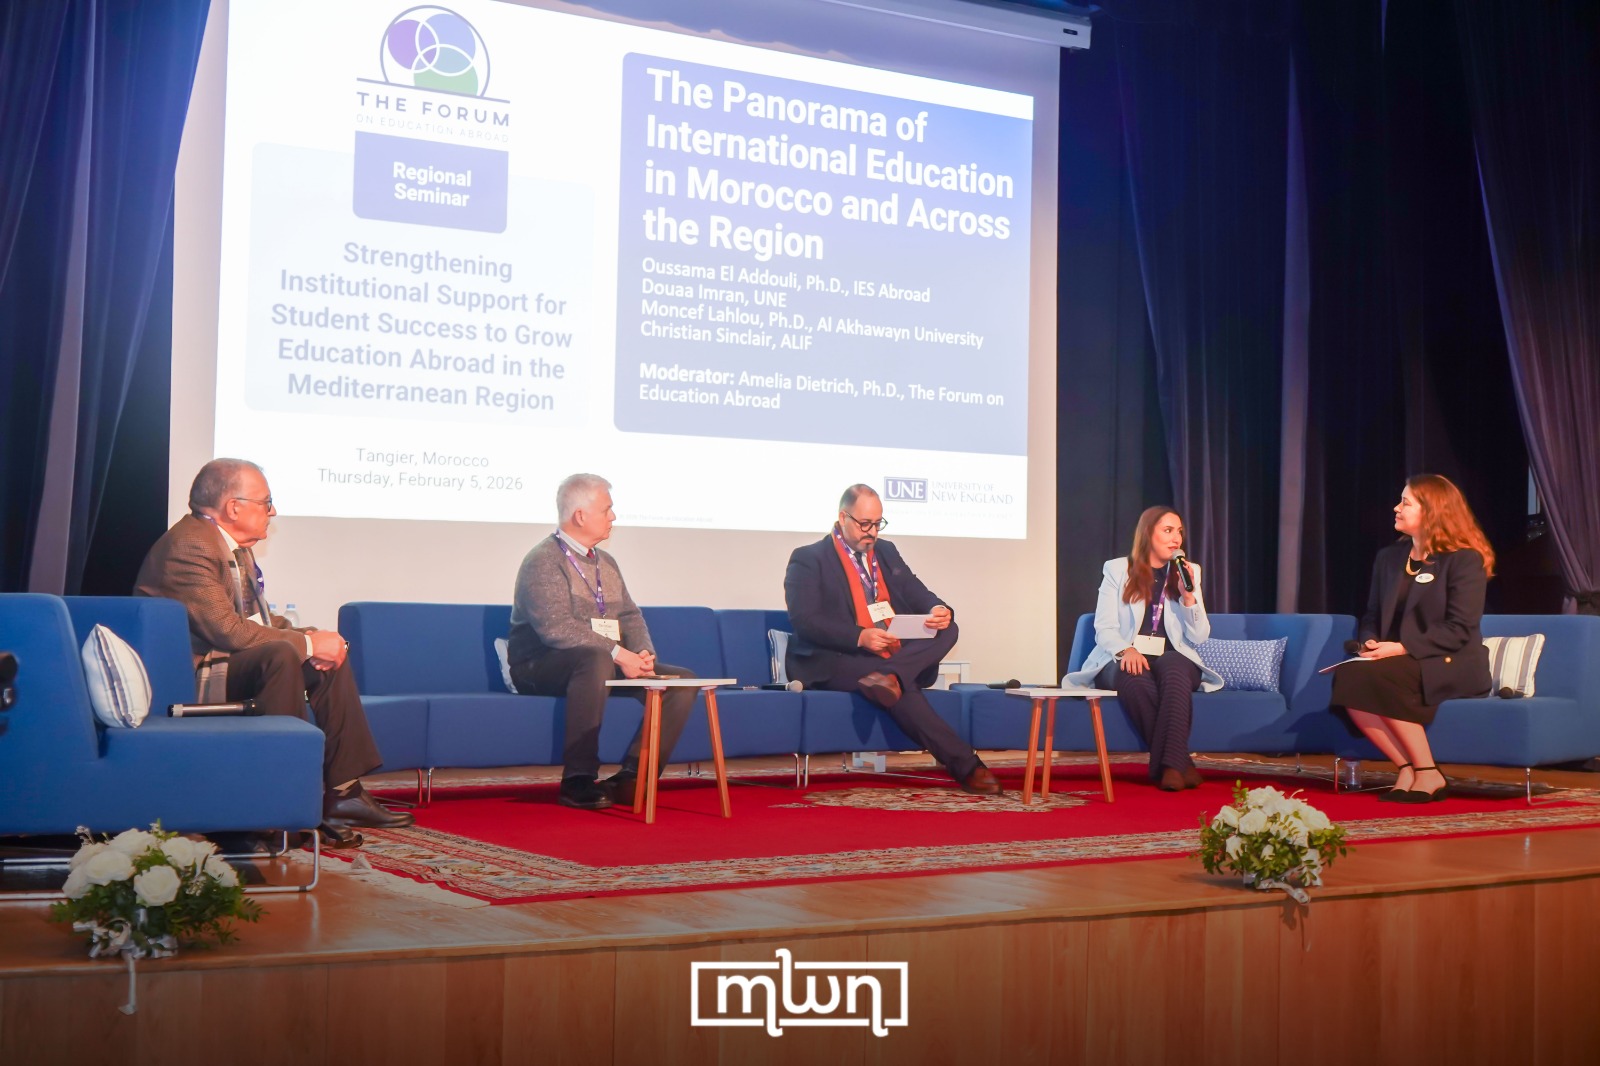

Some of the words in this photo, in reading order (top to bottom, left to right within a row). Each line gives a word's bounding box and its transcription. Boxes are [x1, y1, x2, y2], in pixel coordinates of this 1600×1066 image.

[356, 92, 407, 112] THE
[422, 102, 509, 127] FORUM
[647, 68, 712, 109] The
[724, 81, 887, 138] Panorama
[896, 112, 928, 142] of
[356, 114, 373, 124] ON
[381, 117, 454, 135] EDUCATION
[460, 128, 509, 142] ABROAD
[393, 162, 471, 187] Regional
[647, 114, 856, 176] International
[867, 149, 1013, 198] Education
[394, 183, 469, 207] Seminar
[645, 160, 676, 196] in
[688, 166, 833, 216] Morocco
[842, 194, 898, 225] and
[907, 198, 1010, 239] Across
[643, 207, 699, 245] the
[710, 215, 824, 261] Region
[343, 242, 513, 282] Strengthening
[642, 258, 715, 280] Oussama
[720, 266, 734, 281] El
[738, 269, 801, 291] Addouli,
[806, 274, 849, 295] Ph.D.,
[854, 280, 875, 296] IES
[879, 285, 930, 303] Abroad
[281, 269, 429, 302] Institutional
[437, 284, 528, 313] Support
[535, 293, 567, 315] for
[642, 280, 694, 298] Douaa
[698, 285, 749, 306] Imran,
[754, 290, 787, 308] UNE
[271, 304, 370, 332] Student
[377, 313, 477, 340] Success
[485, 323, 507, 342] to
[515, 325, 573, 347] Grow
[640, 320, 712, 342] Christian
[716, 328, 776, 350] Sinclair,
[780, 333, 813, 350] ALIF
[641, 300, 703, 320] Moncef
[708, 306, 764, 328] Lahlou,
[769, 312, 813, 332] Ph.D.,
[817, 316, 832, 332] Al
[836, 318, 910, 342] Akhawayn
[915, 326, 984, 349] University
[278, 338, 402, 367] Education
[410, 349, 495, 374] Abroad
[502, 355, 522, 375] in
[529, 358, 565, 379] the
[288, 374, 468, 405] Mediterranean
[475, 387, 554, 412] Region
[640, 363, 734, 385] Moderator:
[739, 371, 792, 389] Amelia
[797, 375, 858, 397] Dietrich,
[863, 380, 905, 401] Ph.D.,
[909, 384, 935, 401] The
[939, 388, 983, 405] Forum
[986, 392, 1004, 406] on
[640, 384, 719, 406] Education
[723, 390, 780, 409] Abroad
[356, 448, 418, 467] Tangier,
[423, 452, 489, 467] Morocco
[318, 469, 394, 488] Thursday,
[399, 472, 465, 491] February
[470, 475, 482, 491] 5,
[487, 476, 523, 490] 2026
[888, 481, 924, 498] UNE
[932, 482, 981, 491] UNIVERSITY
[984, 483, 995, 491] OF
